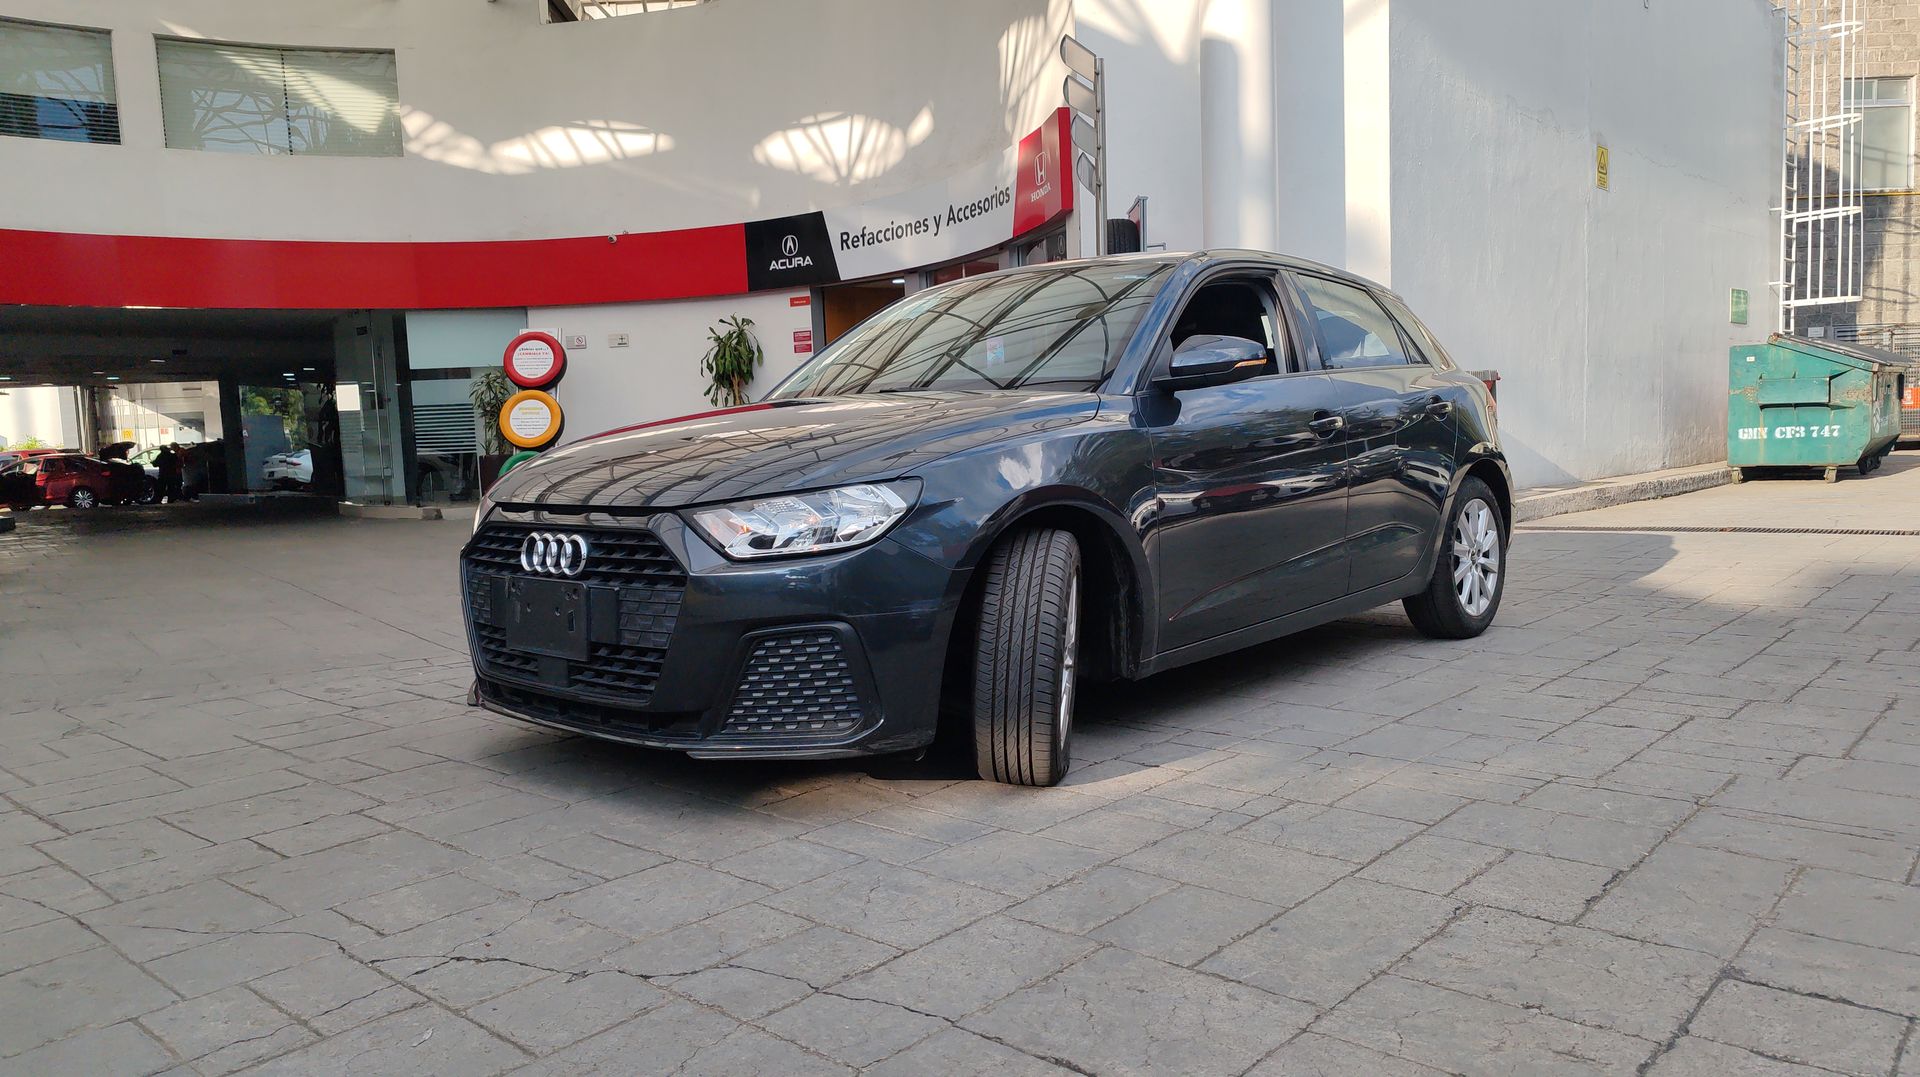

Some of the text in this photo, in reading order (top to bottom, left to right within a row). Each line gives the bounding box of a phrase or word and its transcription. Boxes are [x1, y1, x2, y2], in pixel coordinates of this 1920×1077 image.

[1030, 183, 1052, 202] HONDA
[840, 185, 1011, 251] Refacciones y Accesorios
[769, 255, 814, 271] ACURA
[1809, 424, 1841, 438] 747
